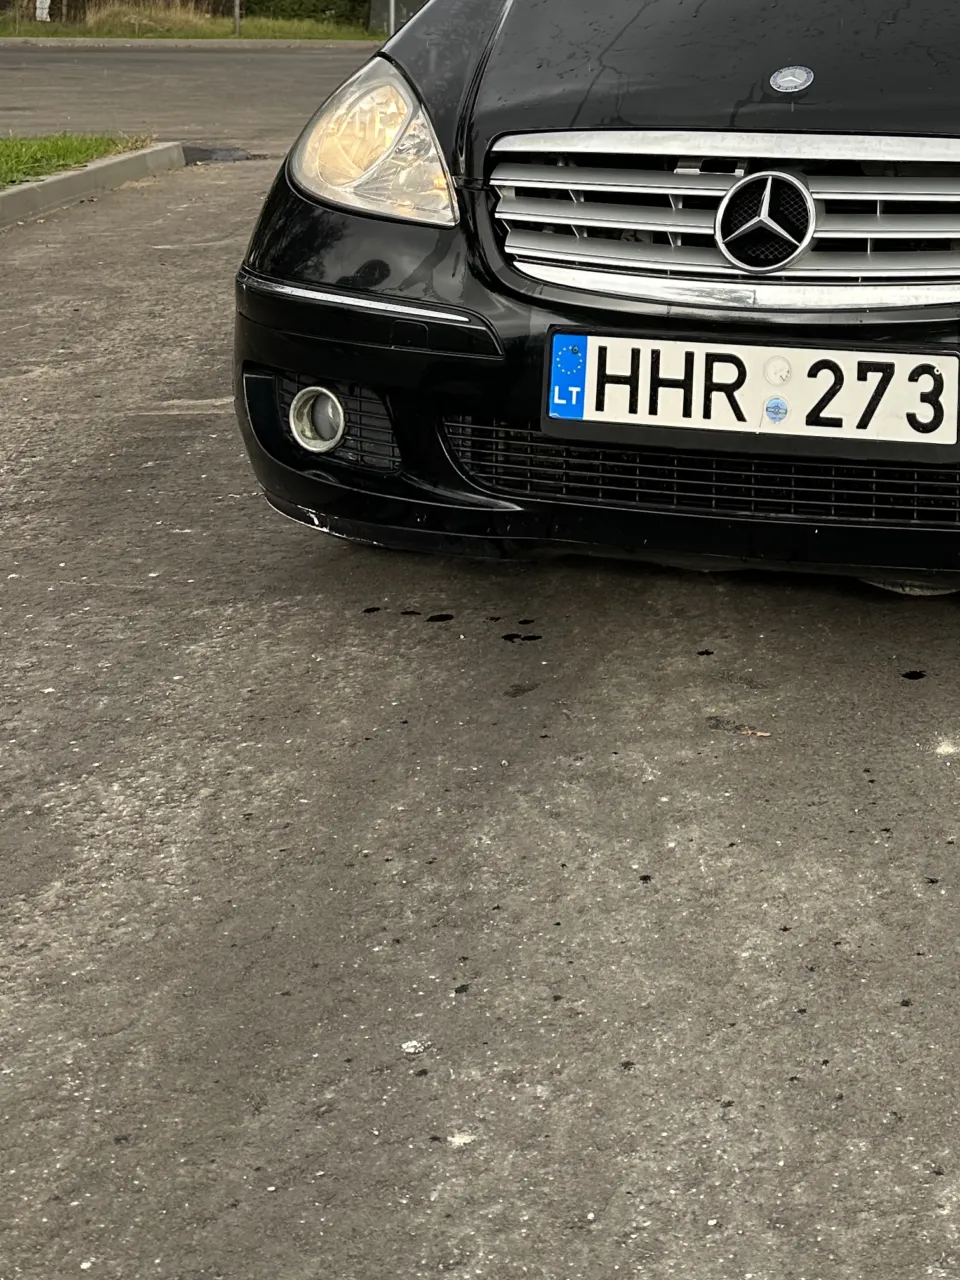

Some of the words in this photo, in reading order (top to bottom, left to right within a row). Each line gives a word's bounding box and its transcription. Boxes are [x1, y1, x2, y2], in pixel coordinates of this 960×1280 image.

[553, 385, 581, 405] LT
[595, 345, 747, 422] HHR
[805, 358, 944, 433] 273
